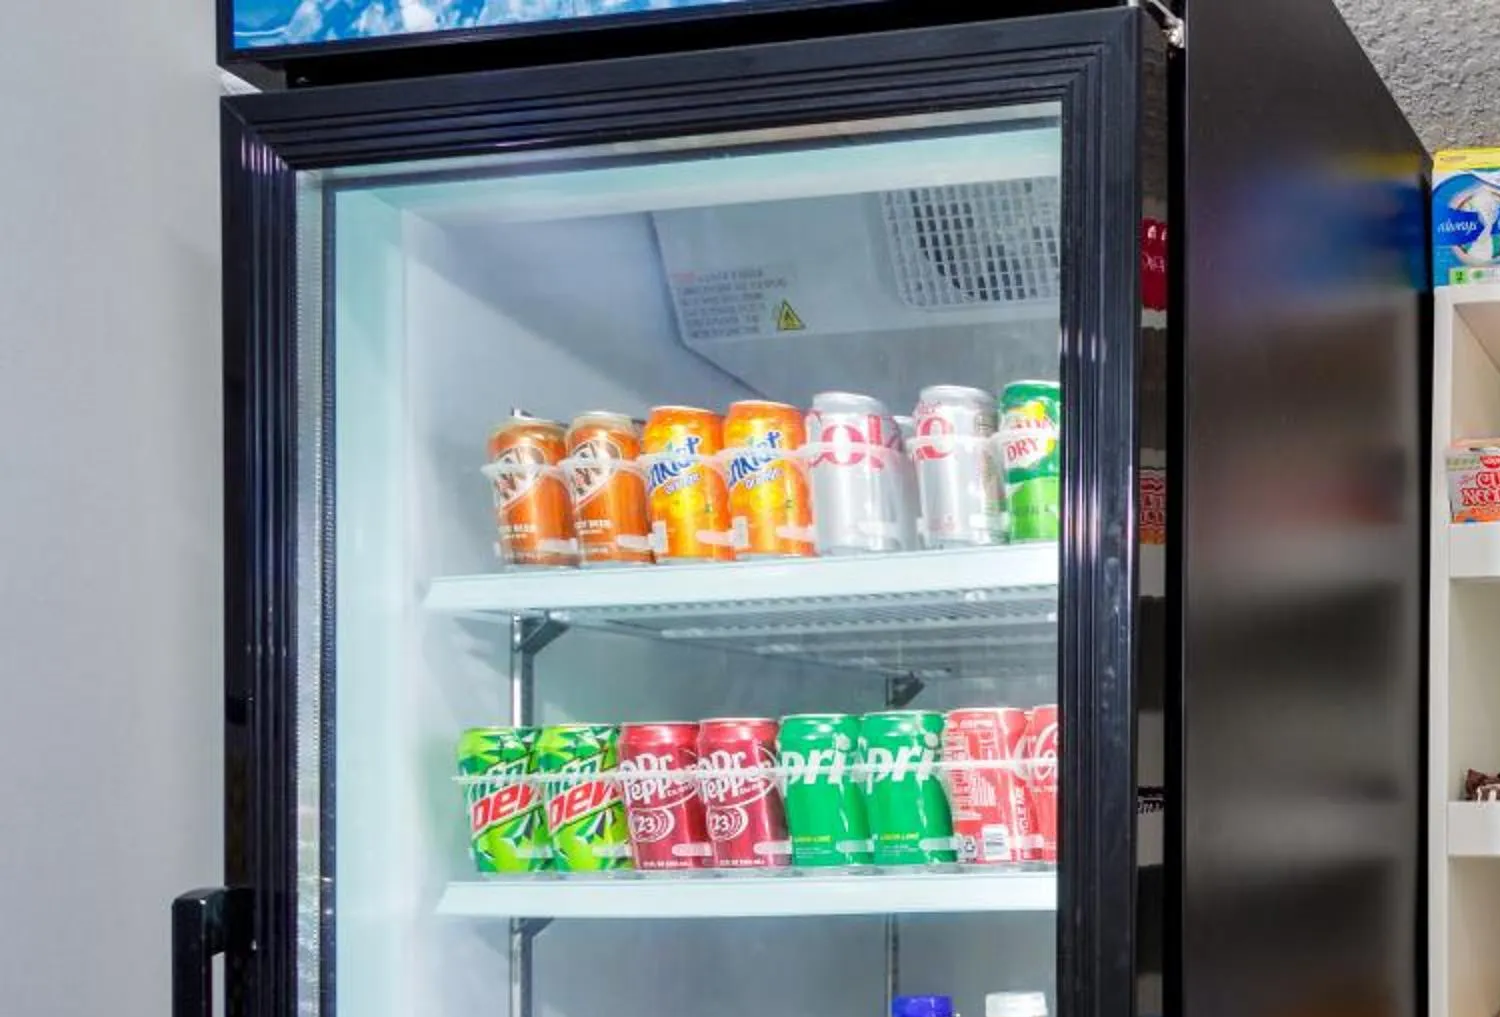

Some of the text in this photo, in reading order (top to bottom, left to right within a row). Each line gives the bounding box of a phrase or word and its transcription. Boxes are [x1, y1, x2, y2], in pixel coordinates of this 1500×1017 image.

[1005, 437, 1040, 462] DRY
[637, 817, 656, 829] 23
[712, 817, 730, 830] 23
